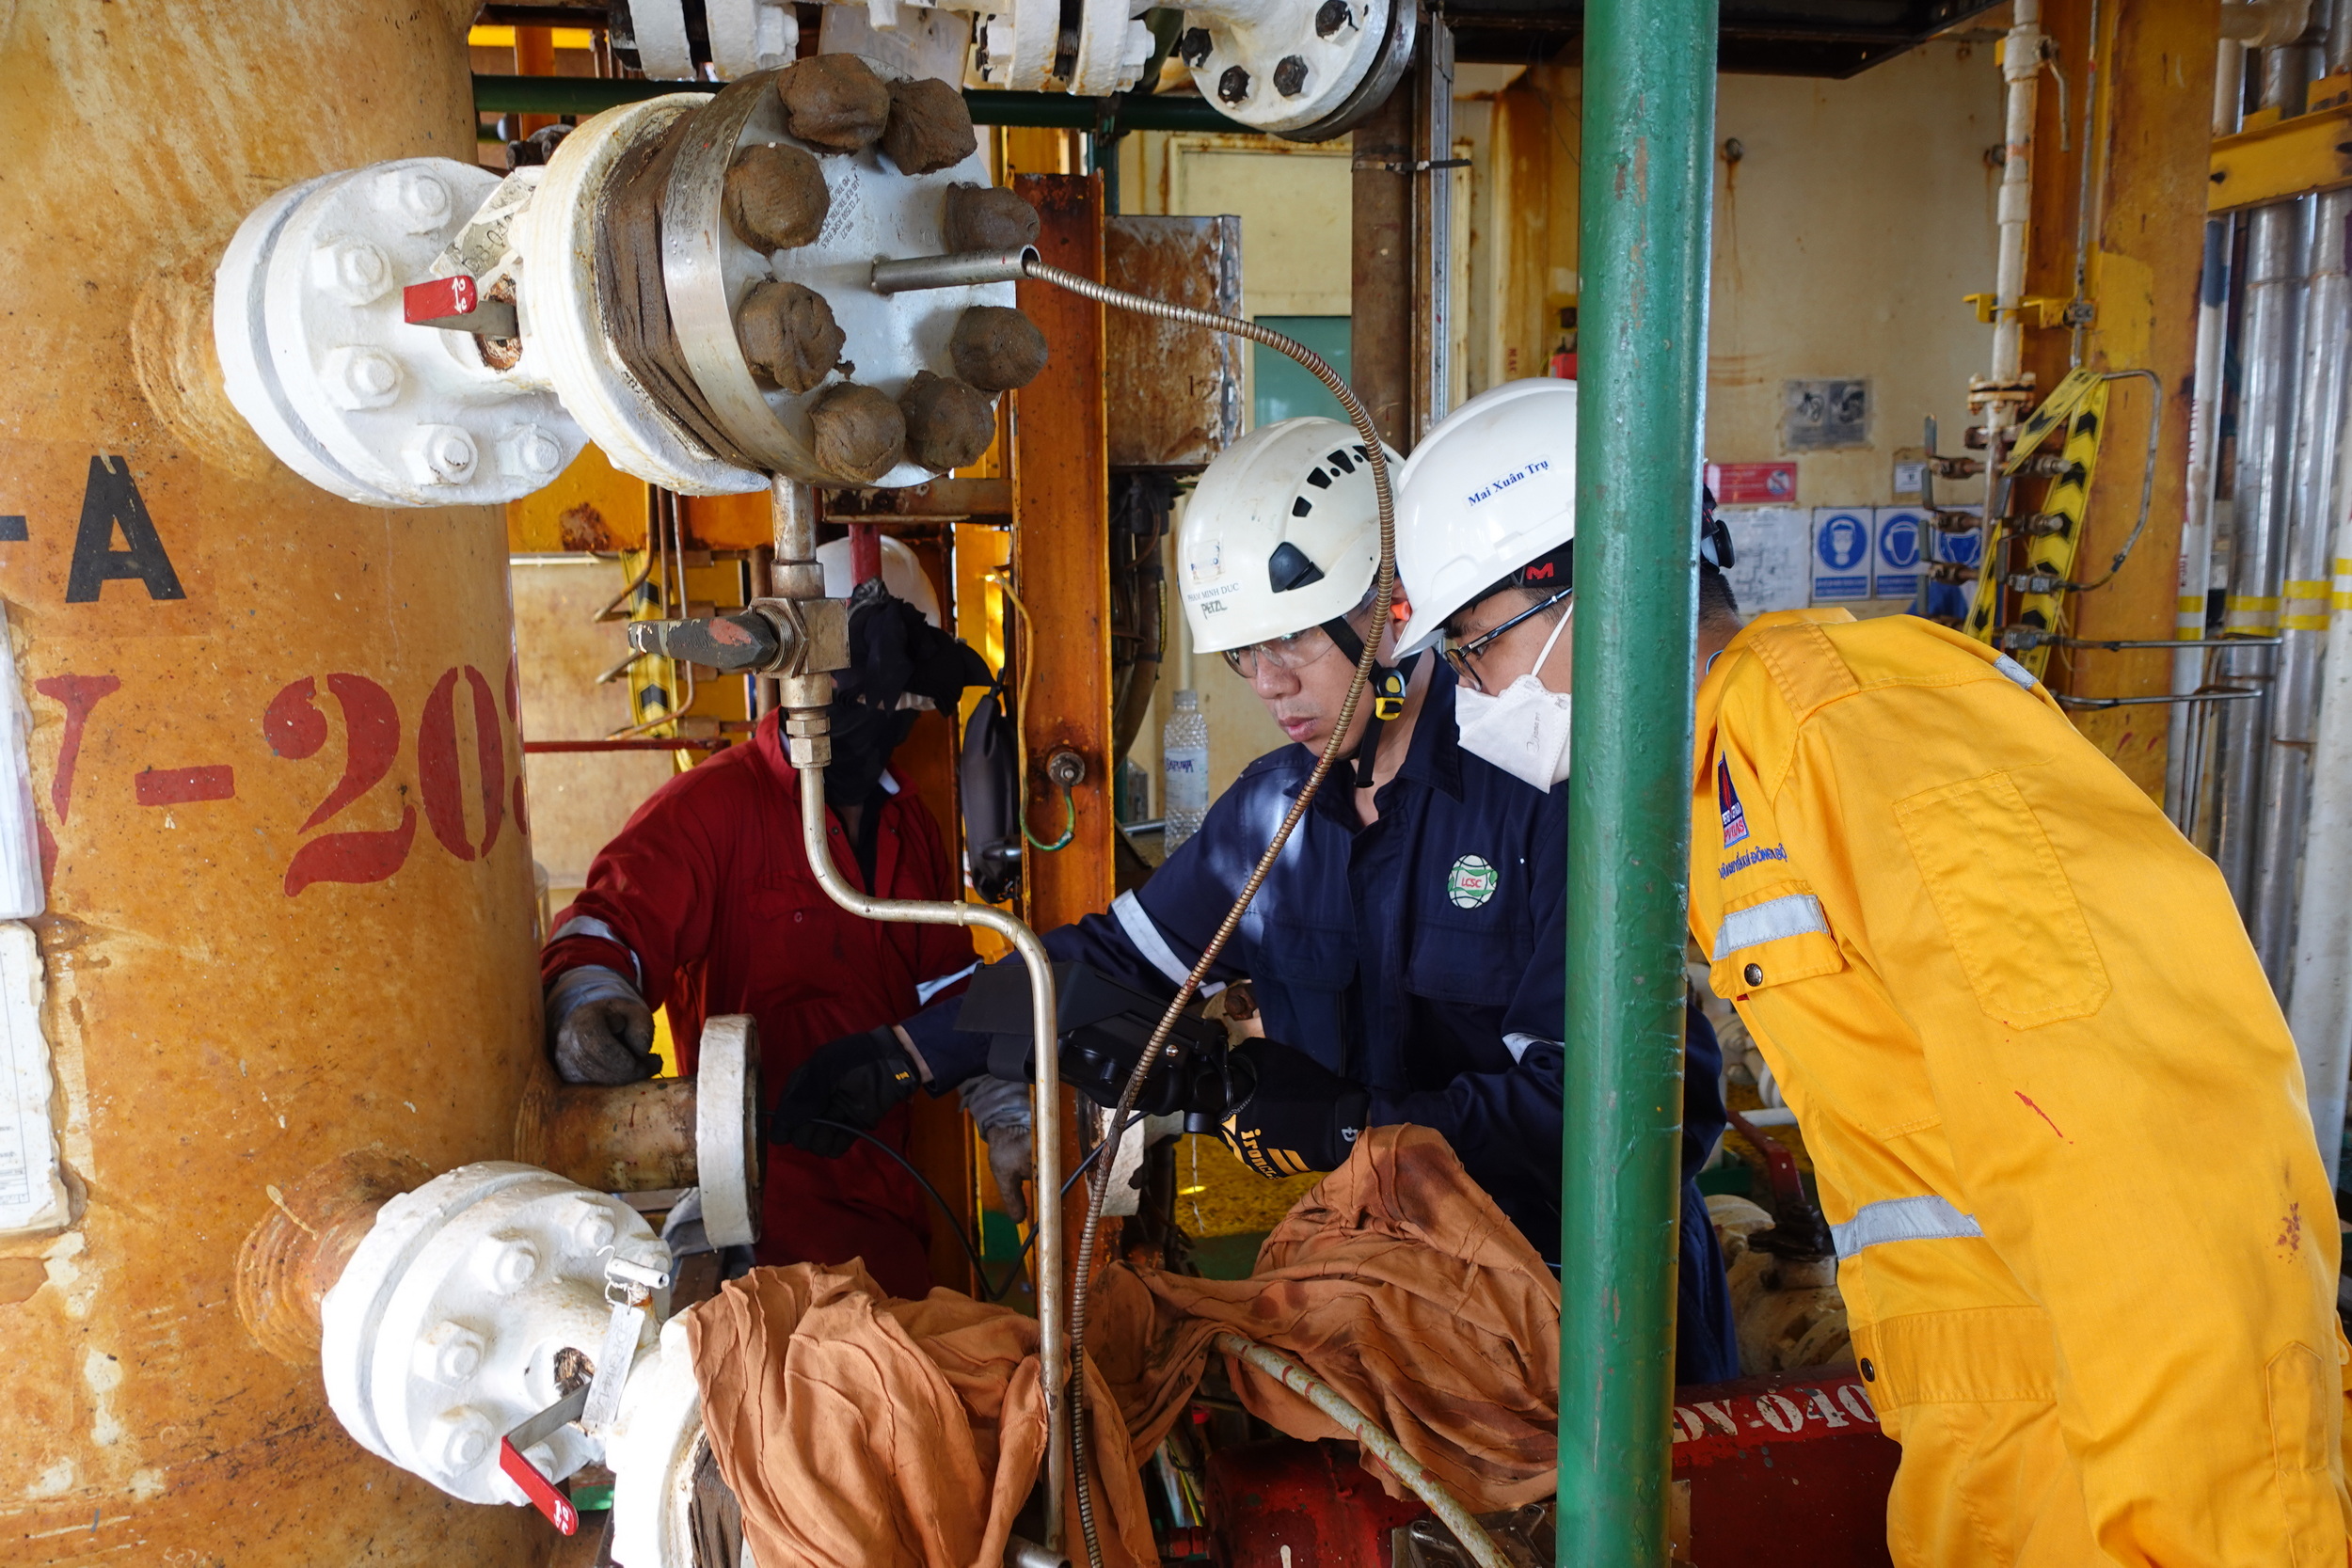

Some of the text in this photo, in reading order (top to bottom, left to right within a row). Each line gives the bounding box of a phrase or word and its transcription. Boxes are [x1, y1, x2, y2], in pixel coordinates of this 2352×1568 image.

[1468, 460, 1549, 507] Mai Xuân Trụ
[1201, 588, 1220, 599] MINH
[1220, 582, 1240, 594] DUC
[1200, 600, 1229, 620] PETZL
[1461, 877, 1483, 888] LCSC
